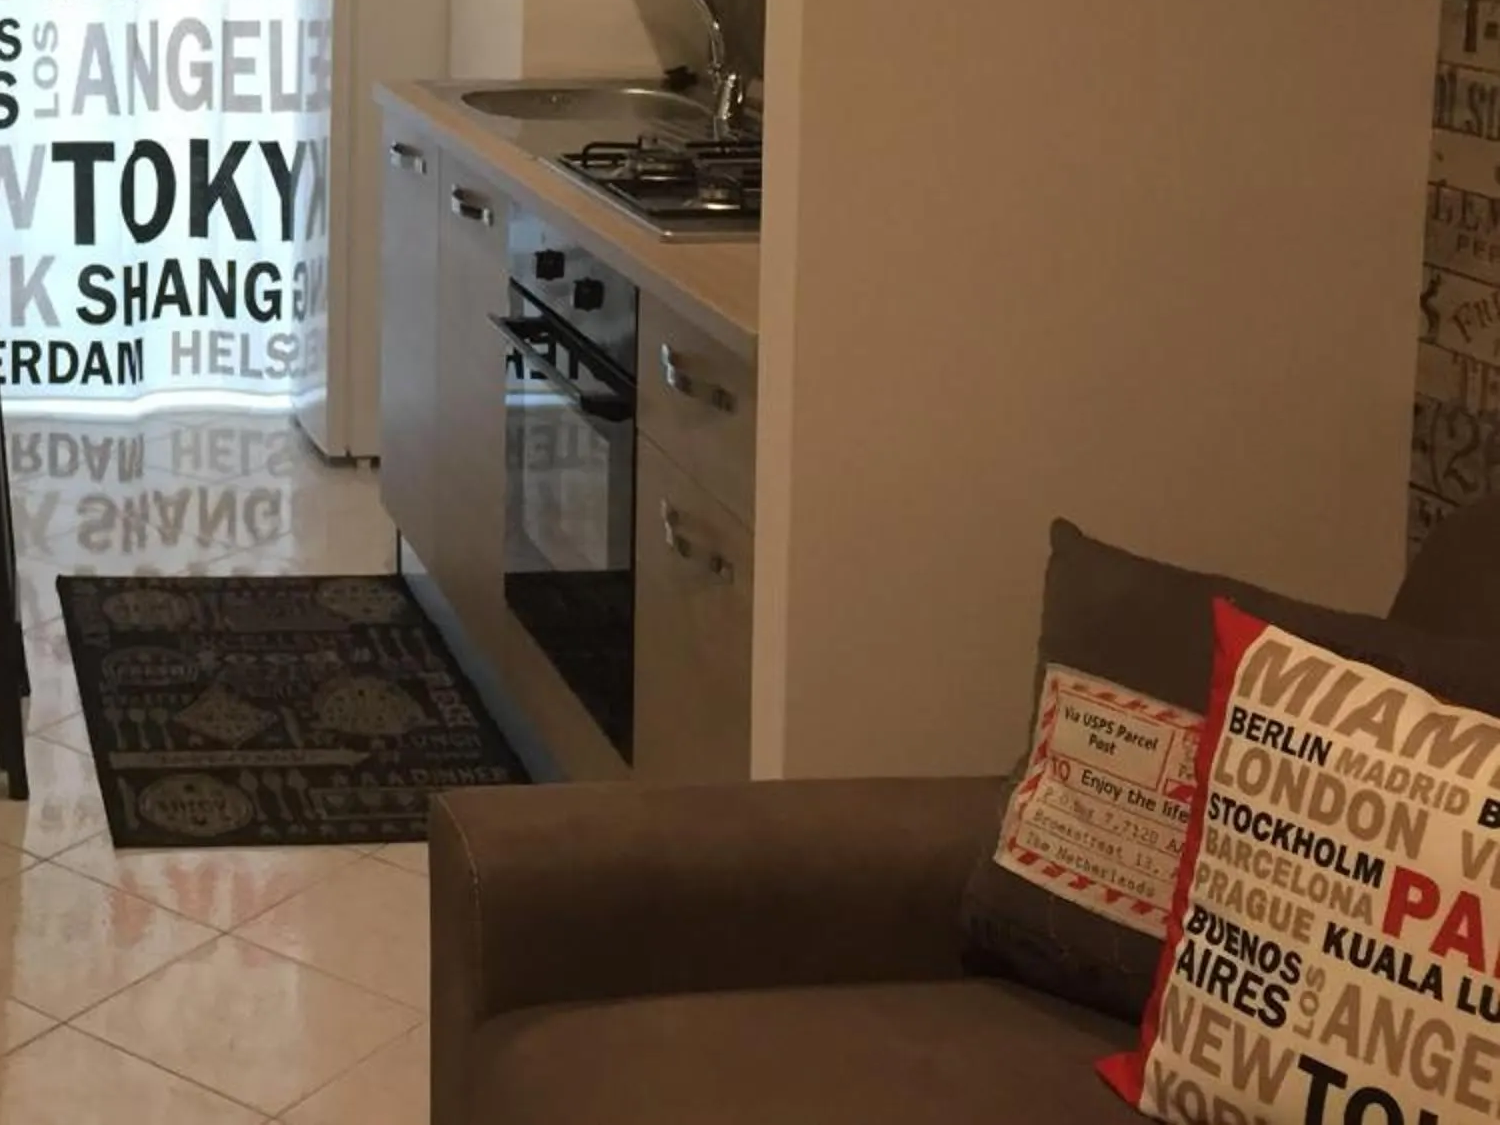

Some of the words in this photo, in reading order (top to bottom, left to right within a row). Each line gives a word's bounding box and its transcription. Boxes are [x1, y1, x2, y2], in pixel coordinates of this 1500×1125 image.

[33, 21, 59, 119] LOS
[76, 259, 283, 327] SHANG
[1083, 712, 1114, 735] USPS
[1116, 726, 1160, 751] Parcel
[1088, 734, 1117, 756] Post
[1228, 706, 1333, 767] BERLIN
[1333, 747, 1470, 816] MADRID
[1236, 639, 1500, 790] MIAM
[1080, 769, 1124, 802] Enjoy
[1127, 788, 1157, 813] the
[1212, 736, 1429, 860] LONDON
[1205, 828, 1374, 925] BARCELONA
[1207, 793, 1385, 888] STOCKHOLM
[1382, 865, 1500, 979] PA
[1186, 903, 1303, 985] BUENOS
[1194, 862, 1315, 943] PRAGUE
[1322, 922, 1444, 1001] KUALA
[1176, 940, 1290, 1028] AIRES
[1292, 965, 1326, 1040] LOS
[1161, 983, 1295, 1106] NEW
